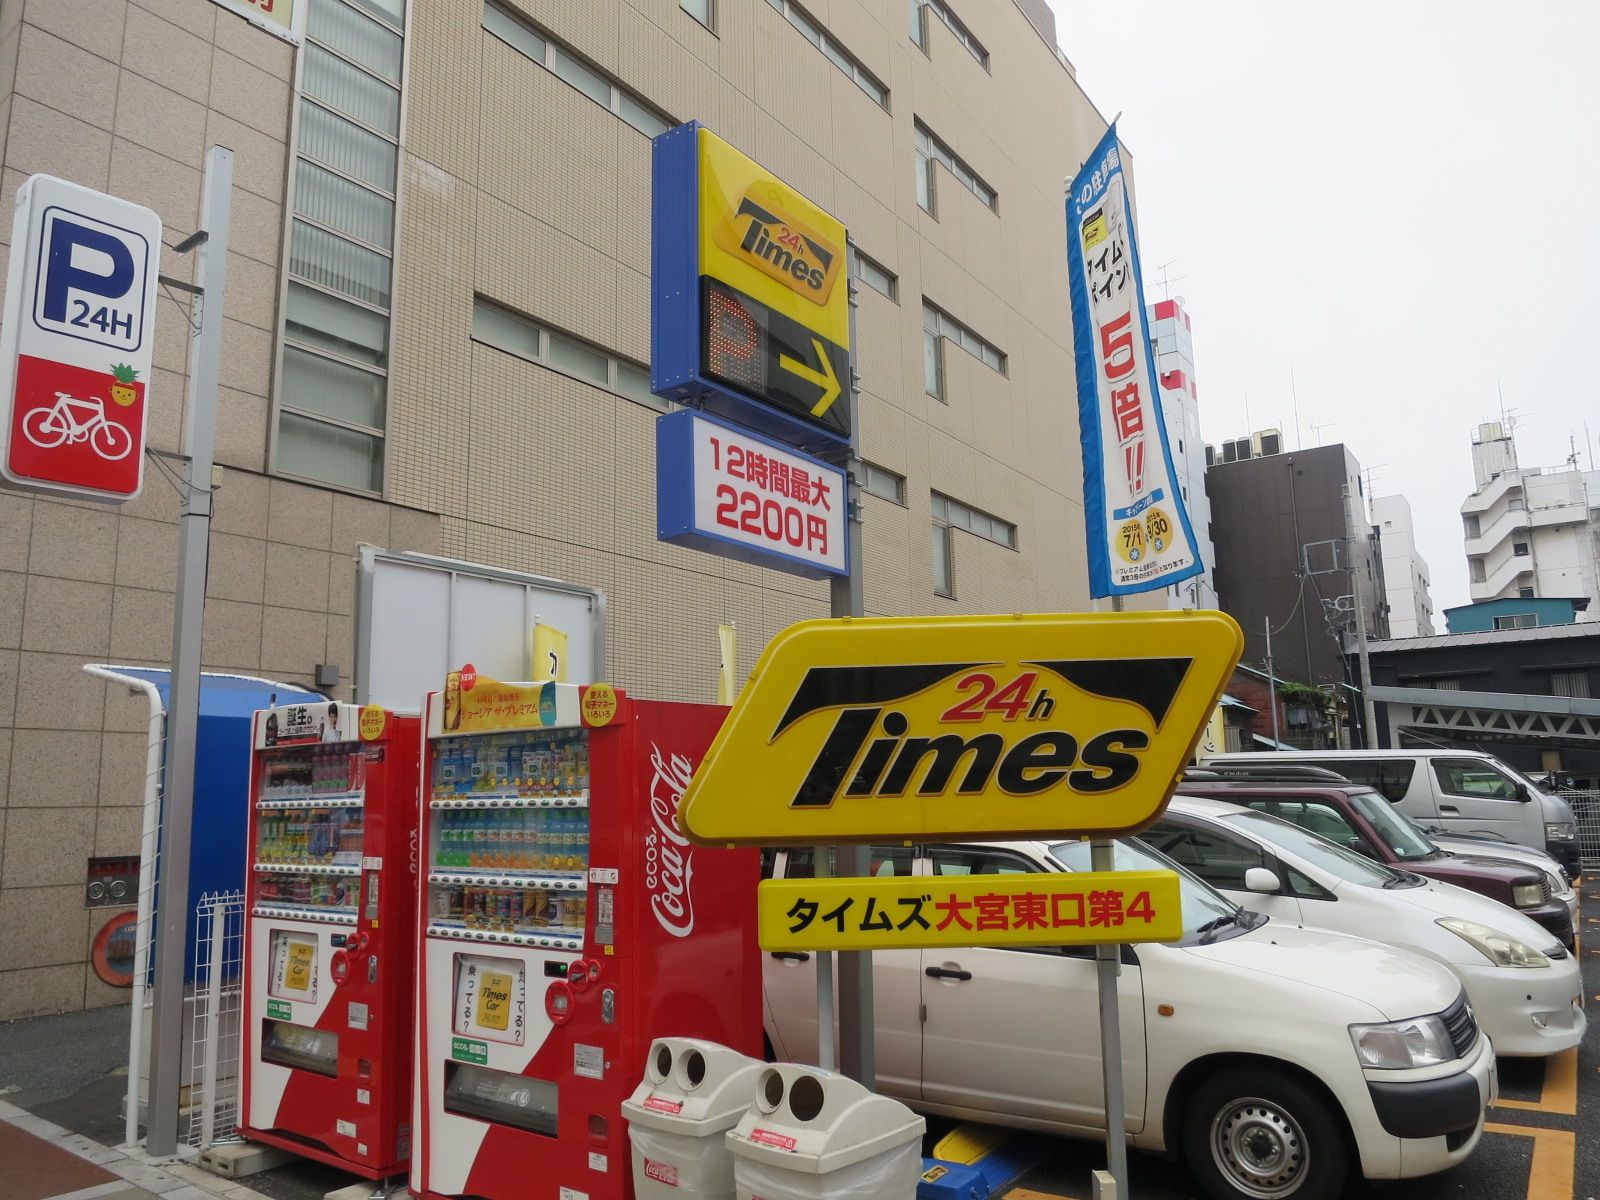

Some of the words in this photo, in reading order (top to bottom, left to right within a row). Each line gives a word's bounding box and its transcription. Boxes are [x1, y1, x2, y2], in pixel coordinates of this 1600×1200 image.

[740, 217, 825, 291] Times
[777, 226, 804, 255] 24h
[42, 217, 135, 324] P
[70, 300, 133, 340] 24H
[710, 437, 831, 512] 12時間最大
[716, 483, 828, 555] 2200円
[938, 672, 1056, 723] 24h
[788, 706, 1150, 809] Times
[785, 889, 1157, 934] タイムズ大宮東口第4
[482, 987, 508, 1001] Times
[486, 999, 500, 1011] Car
